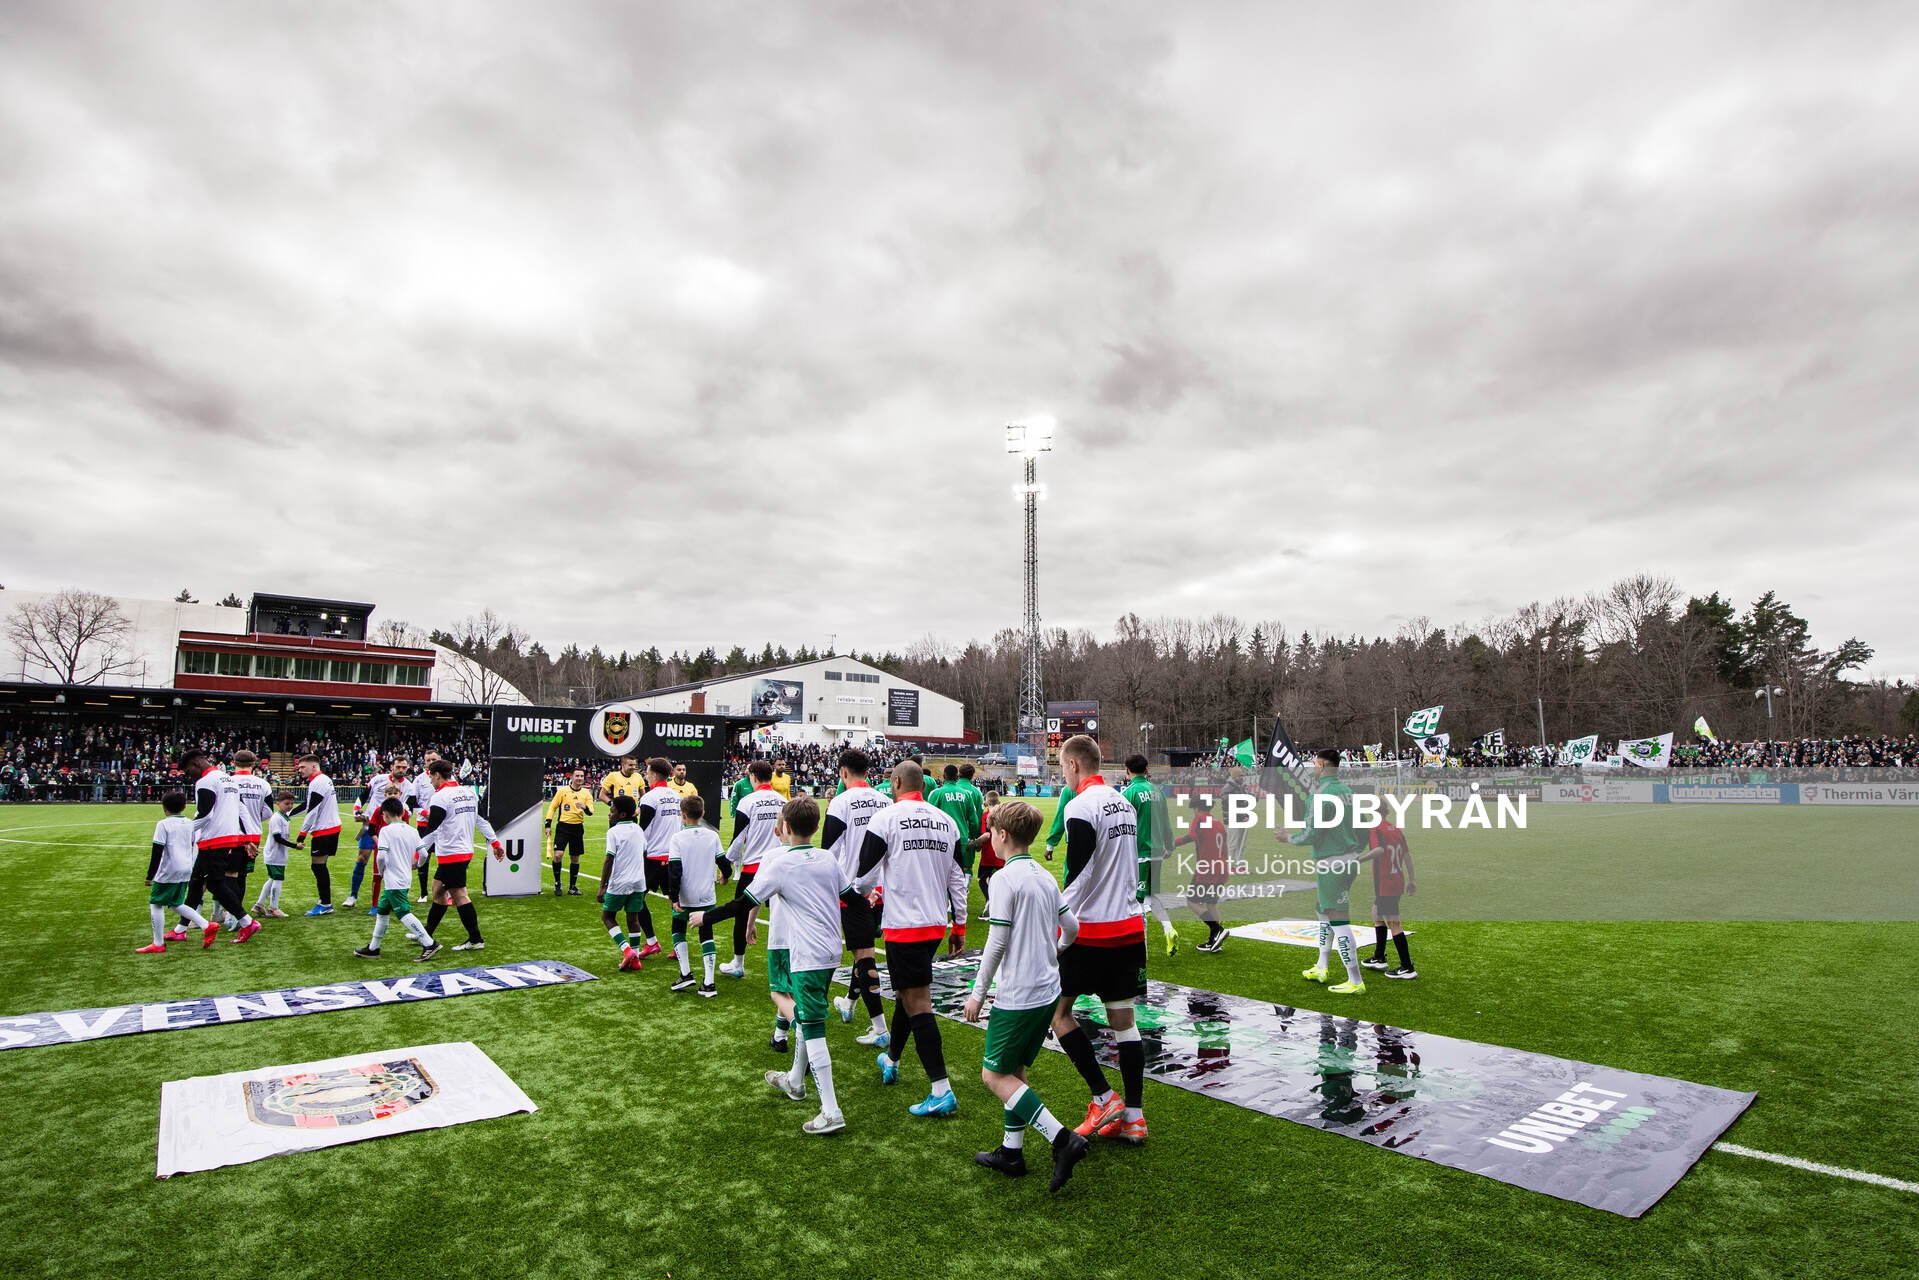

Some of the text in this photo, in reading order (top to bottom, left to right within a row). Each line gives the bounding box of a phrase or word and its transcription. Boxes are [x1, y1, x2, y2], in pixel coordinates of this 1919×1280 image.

[507, 717, 577, 734] UNIBET
[655, 723, 715, 739] UNIBET
[1272, 740, 1320, 794] UNIBE
[944, 791, 966, 803] BAJEN
[1499, 788, 1513, 796] TILL
[1514, 788, 1541, 796] BYGGET
[1822, 788, 1883, 800] Thermia
[900, 817, 949, 833] stadium
[505, 839, 524, 862] U
[0, 965, 566, 1050] SVENSKAN
[1486, 1081, 1628, 1154] UNIBET
